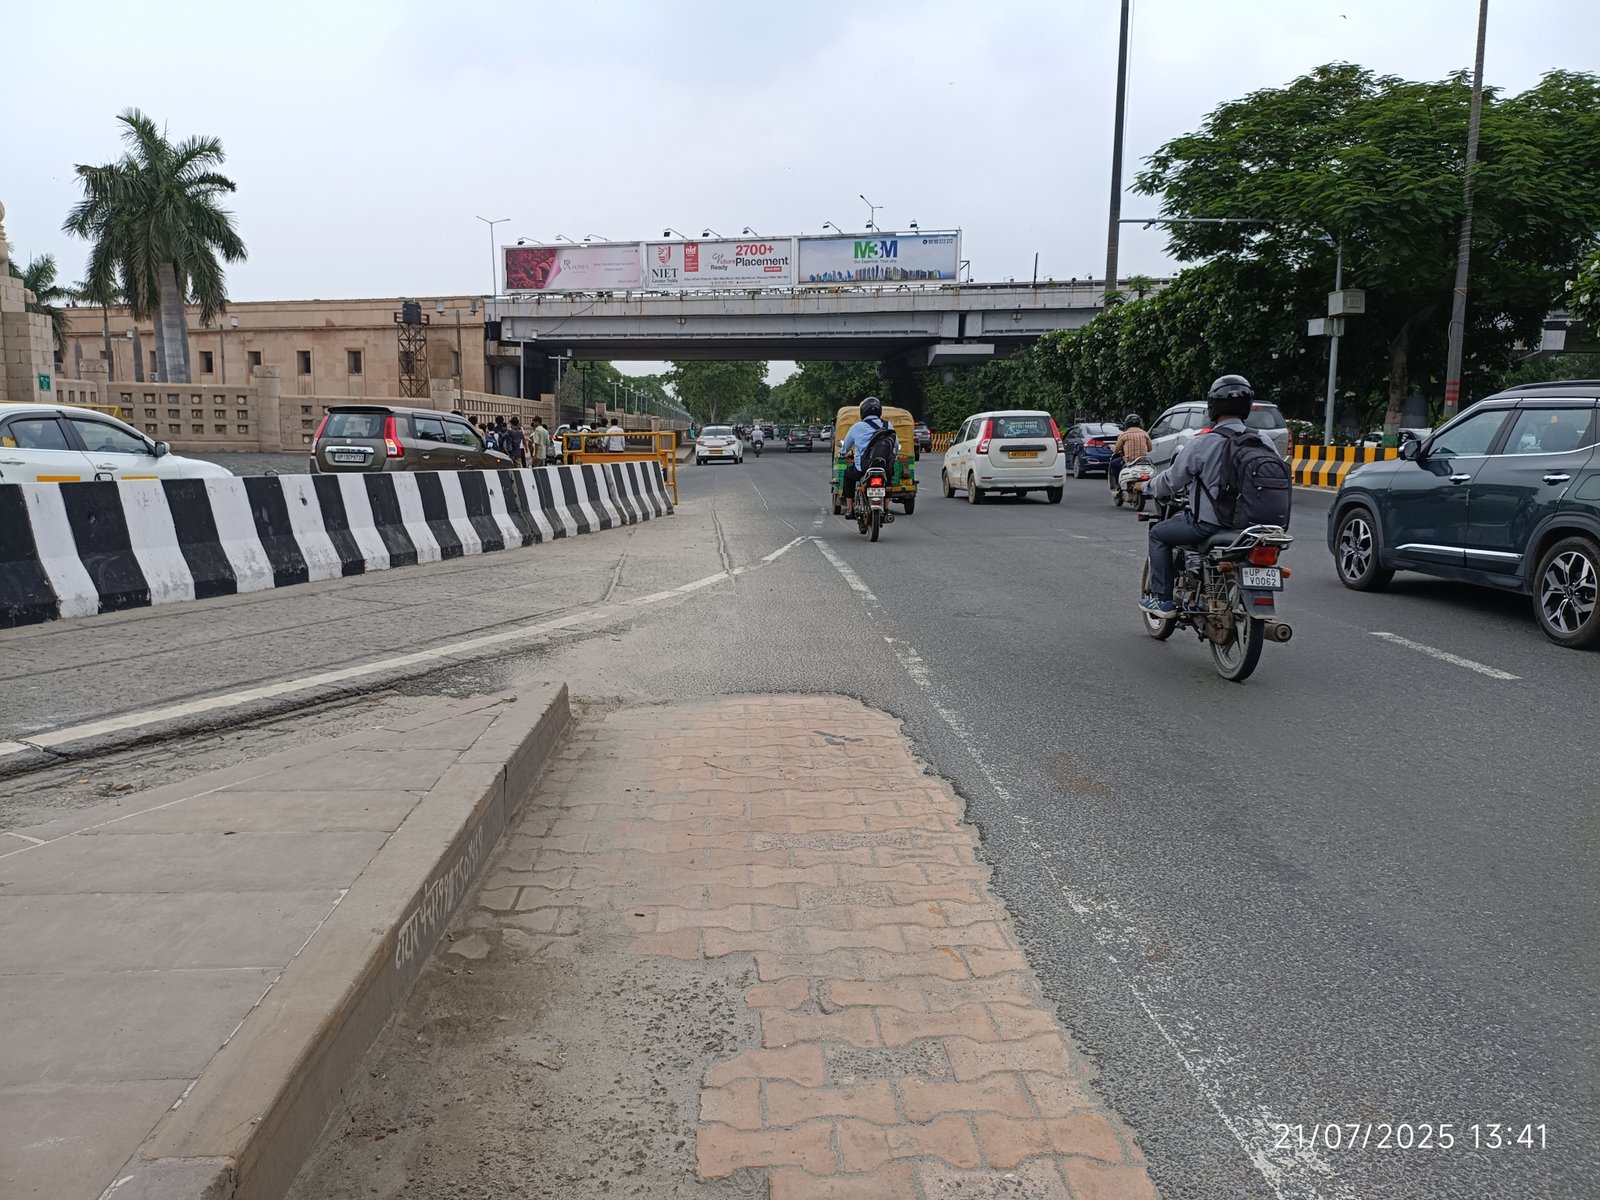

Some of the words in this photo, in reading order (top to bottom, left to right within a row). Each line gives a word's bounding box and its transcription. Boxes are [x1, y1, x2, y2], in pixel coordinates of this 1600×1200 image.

[736, 244, 774, 256] 2700+
[854, 240, 898, 258] M3M
[736, 256, 789, 266] Placement
[652, 268, 678, 278] NIET
[1250, 577, 1276, 586] V0062
